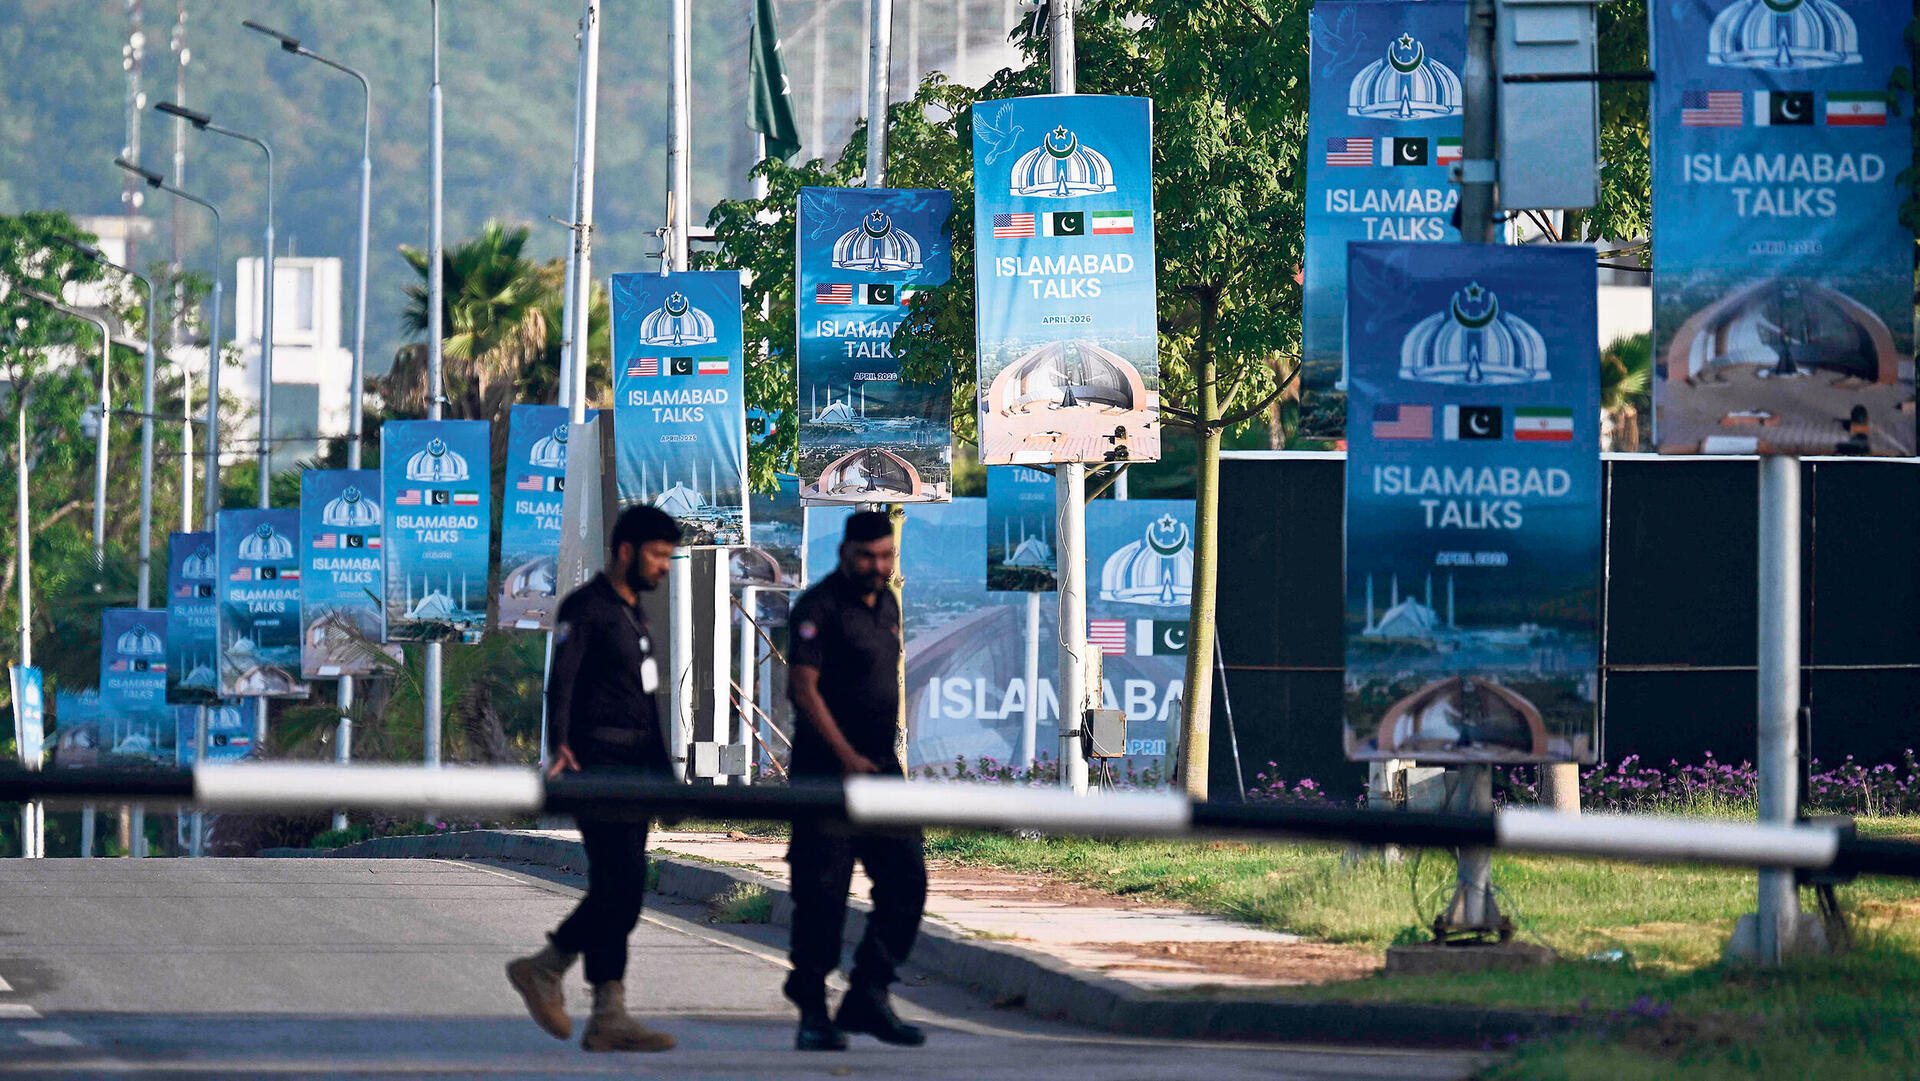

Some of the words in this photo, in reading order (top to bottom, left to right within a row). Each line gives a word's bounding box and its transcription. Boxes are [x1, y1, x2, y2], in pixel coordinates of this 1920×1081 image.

[1684, 153, 1885, 183] ISLAMABAD
[1326, 188, 1459, 213] ISLAMABA
[1732, 187, 1837, 217] TALKS
[1362, 217, 1444, 241] TALKS
[995, 253, 1134, 277] ISLAMABAD
[1028, 277, 1102, 299] TALKS
[1042, 316, 1067, 324] APRIL
[1069, 315, 1092, 323] 2026
[628, 388, 728, 406] ISLAMABAD
[652, 406, 705, 423] TALKS
[1373, 466, 1571, 496] ISLAMABAD
[396, 515, 478, 530] ISLAMABAD
[535, 516, 562, 530] TAL
[1419, 500, 1523, 529] TALKS
[415, 529, 459, 543] TALKS
[312, 557, 381, 571] ISLAMABA
[331, 570, 373, 584] TALKS
[248, 600, 285, 613] TALKS
